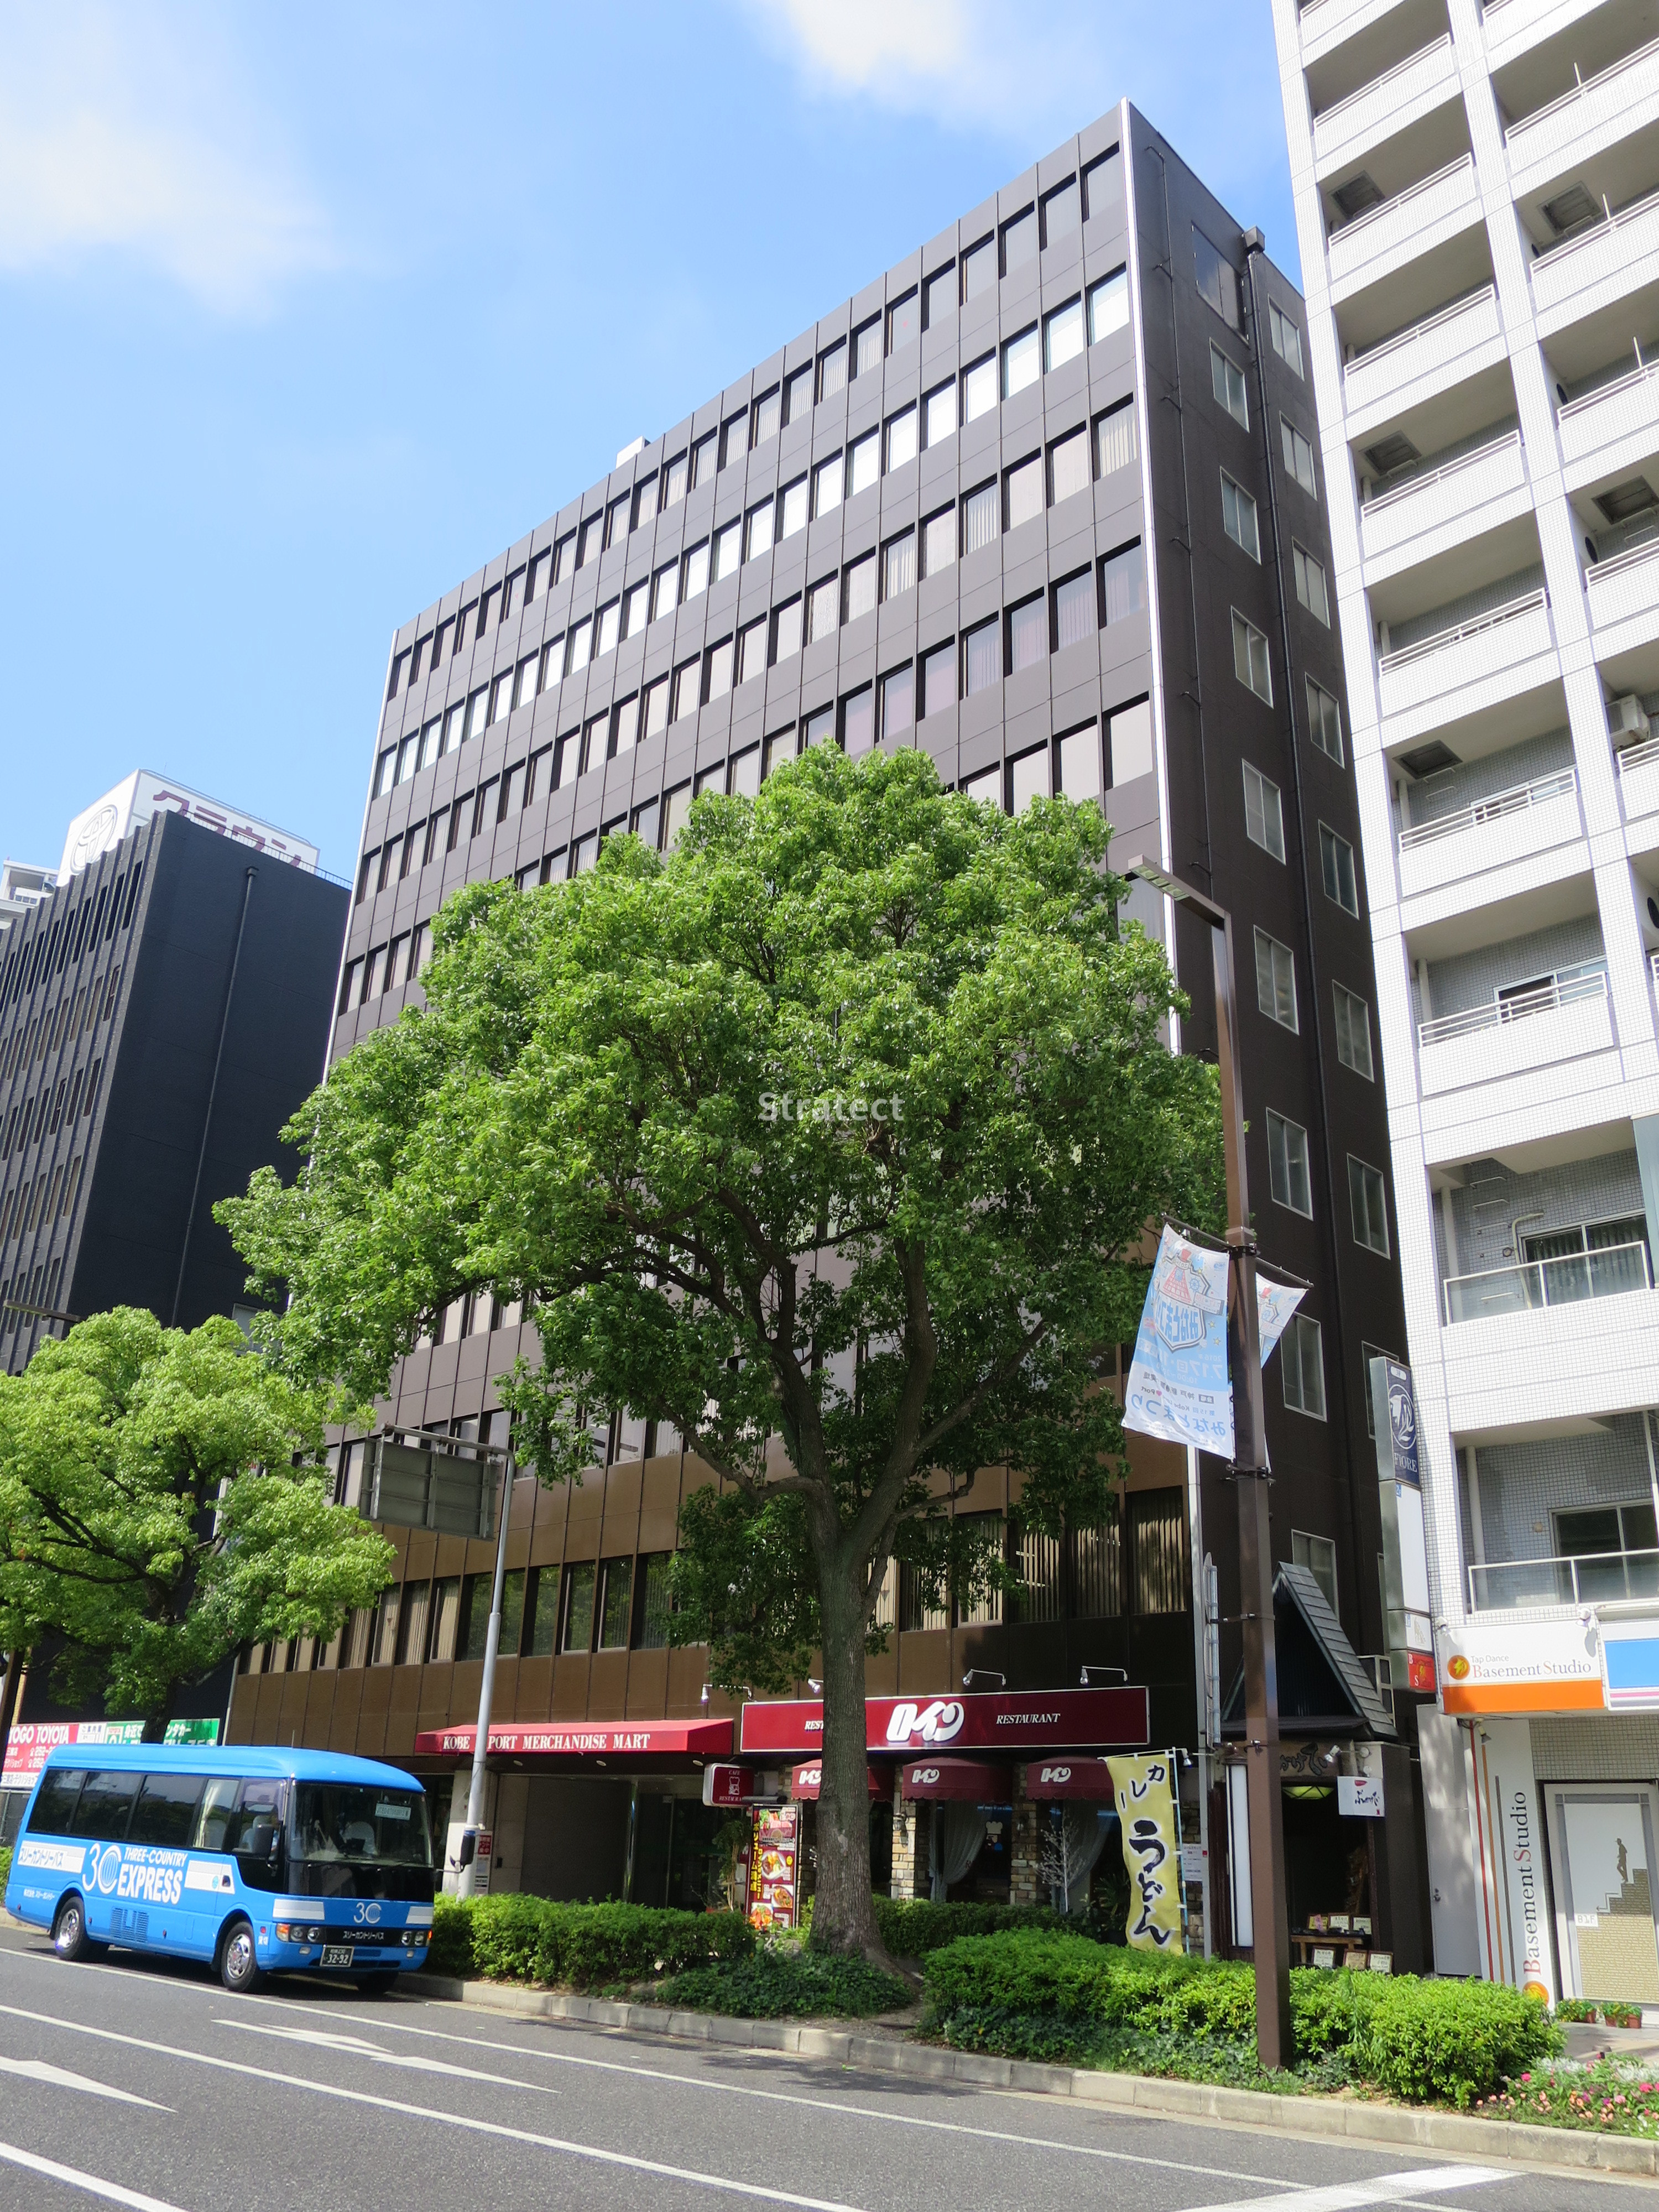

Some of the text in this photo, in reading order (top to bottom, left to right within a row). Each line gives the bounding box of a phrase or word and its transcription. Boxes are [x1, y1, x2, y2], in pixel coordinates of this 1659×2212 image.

[1394, 1452, 1417, 1472] FIORE
[1471, 1655, 1484, 1663] Tap
[1473, 1659, 1591, 1678] Basement Studio
[996, 1713, 1060, 1725] RESTAURANT
[8, 1725, 69, 1744] YOGO TOYOTA
[443, 1733, 650, 1750] KOBE PORT MERCHANDISE MART
[19, 1848, 64, 1867] スリーカントリーバス
[124, 1846, 188, 1867] THREE-COUNTRY
[117, 1864, 183, 1905] EXPRESS
[1510, 1792, 1542, 1976] Basement Studio
[1577, 1914, 1595, 1923] B1F
[343, 1931, 384, 1939] スリーカントリーバス
